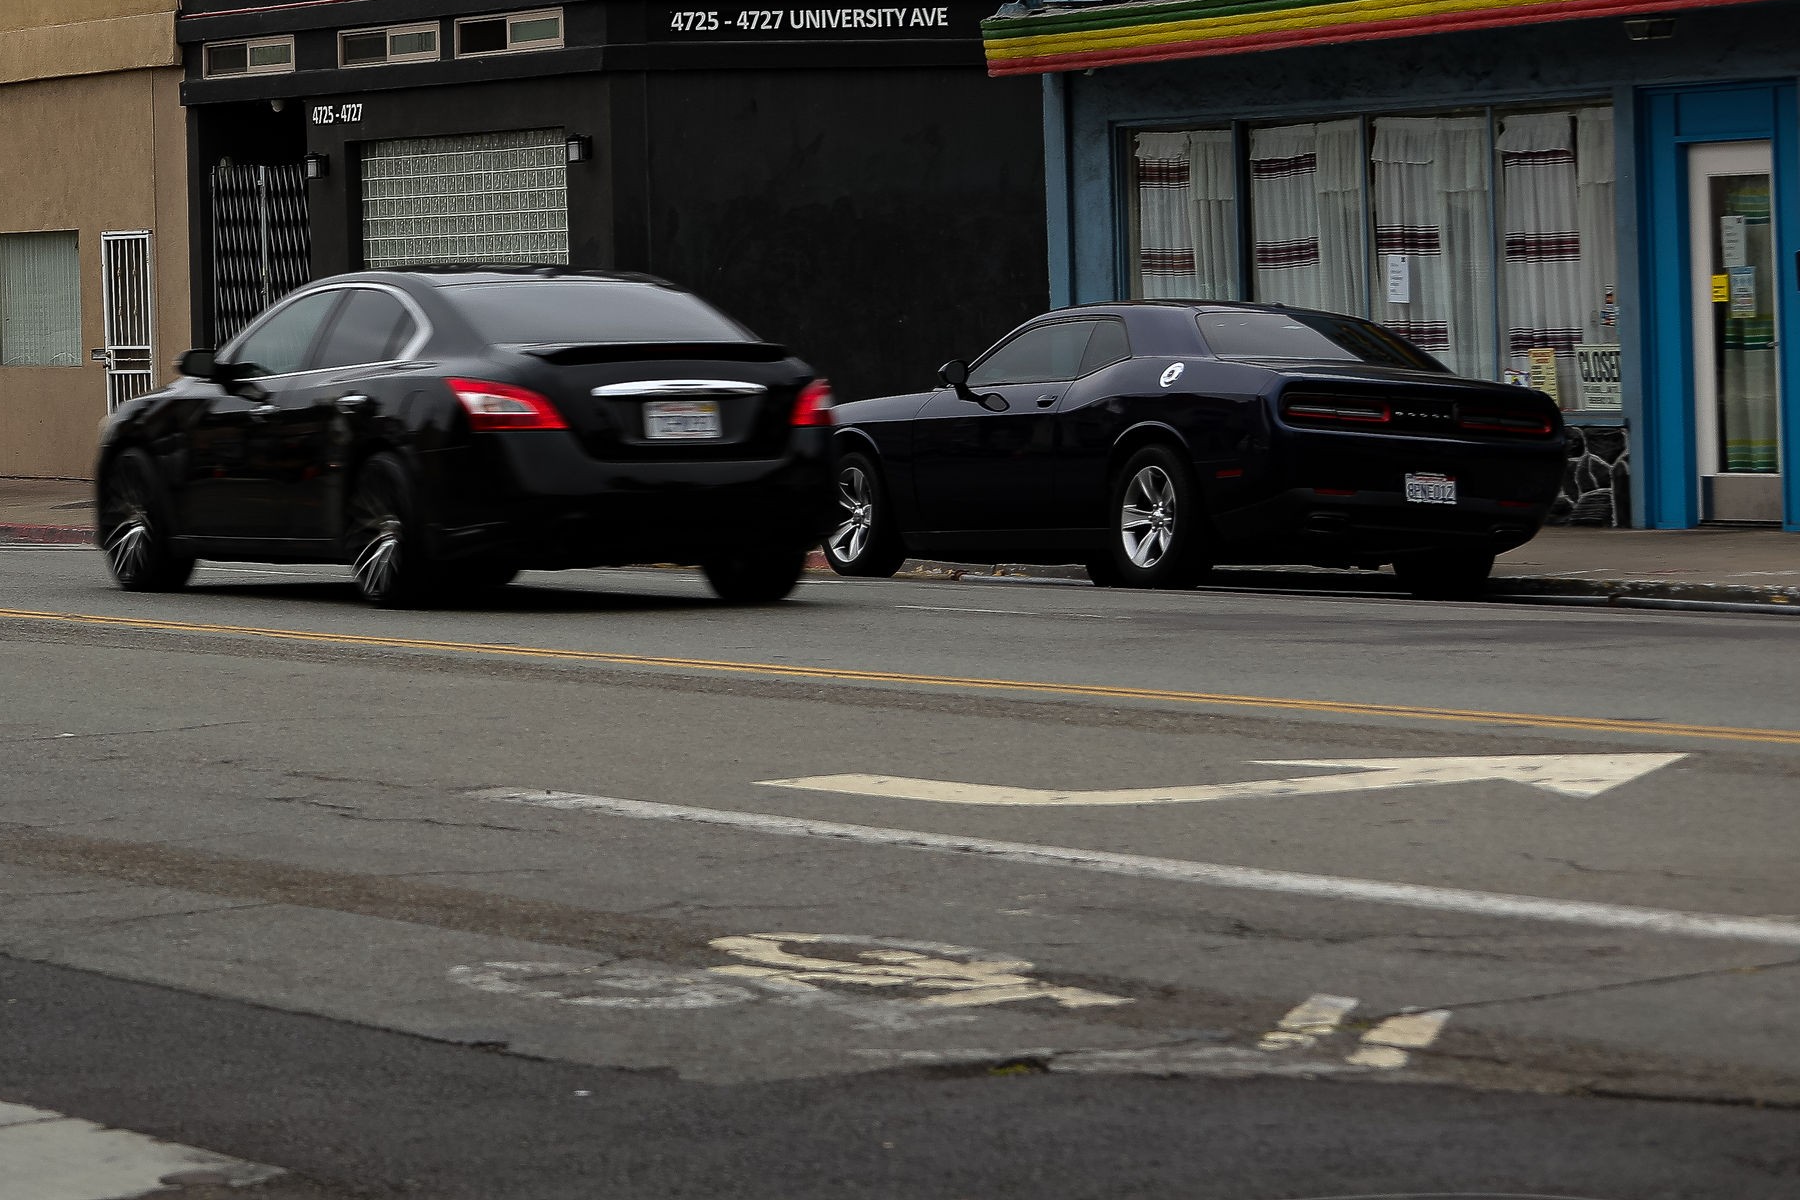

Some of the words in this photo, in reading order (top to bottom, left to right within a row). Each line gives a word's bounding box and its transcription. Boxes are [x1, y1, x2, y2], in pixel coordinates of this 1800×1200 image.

[670, 11, 719, 31] 4725
[736, 10, 783, 30] 4727
[789, 8, 906, 30] UNIVERSITY
[909, 7, 949, 27] AVE
